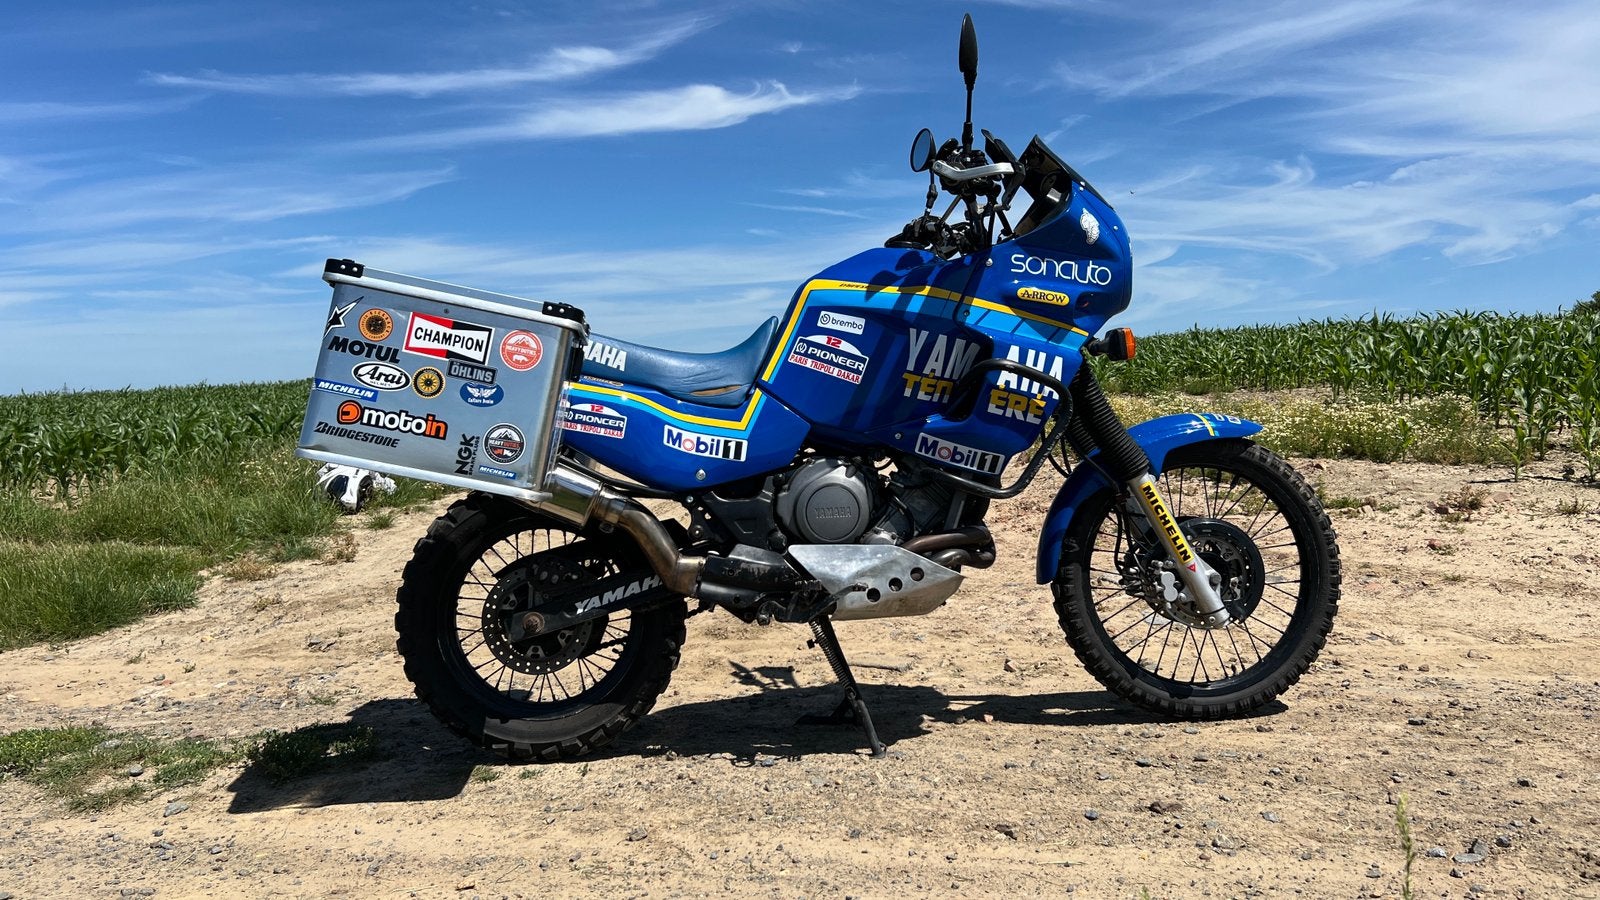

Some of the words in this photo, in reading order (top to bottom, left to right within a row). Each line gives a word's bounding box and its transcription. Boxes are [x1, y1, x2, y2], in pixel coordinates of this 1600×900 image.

[1010, 254, 1112, 286] sonauto
[1020, 288, 1066, 304] ARROW
[831, 317, 863, 330] brembo
[328, 336, 400, 363] MOTUL
[414, 326, 484, 352] CHAMPION
[825, 336, 842, 348] 12
[789, 354, 808, 366] PARIS
[810, 360, 835, 375] TRIPOLI
[836, 369, 860, 384] DAKAR
[807, 346, 864, 371] PIONEER
[357, 366, 404, 385] Arai
[451, 362, 493, 383] ÖHLINS
[318, 381, 375, 399] MICHELIN
[590, 405, 604, 413] 12
[314, 421, 400, 448] BRIDGESTONE
[362, 408, 447, 438] motoin
[454, 433, 475, 476] NGK
[666, 429, 721, 457] Mobil
[918, 436, 978, 468] Mobil
[479, 466, 515, 478] MICHELIN
[814, 506, 852, 519] YAMAHA
[1142, 485, 1191, 561] MICHELIN
[574, 574, 663, 615] YAMAH
